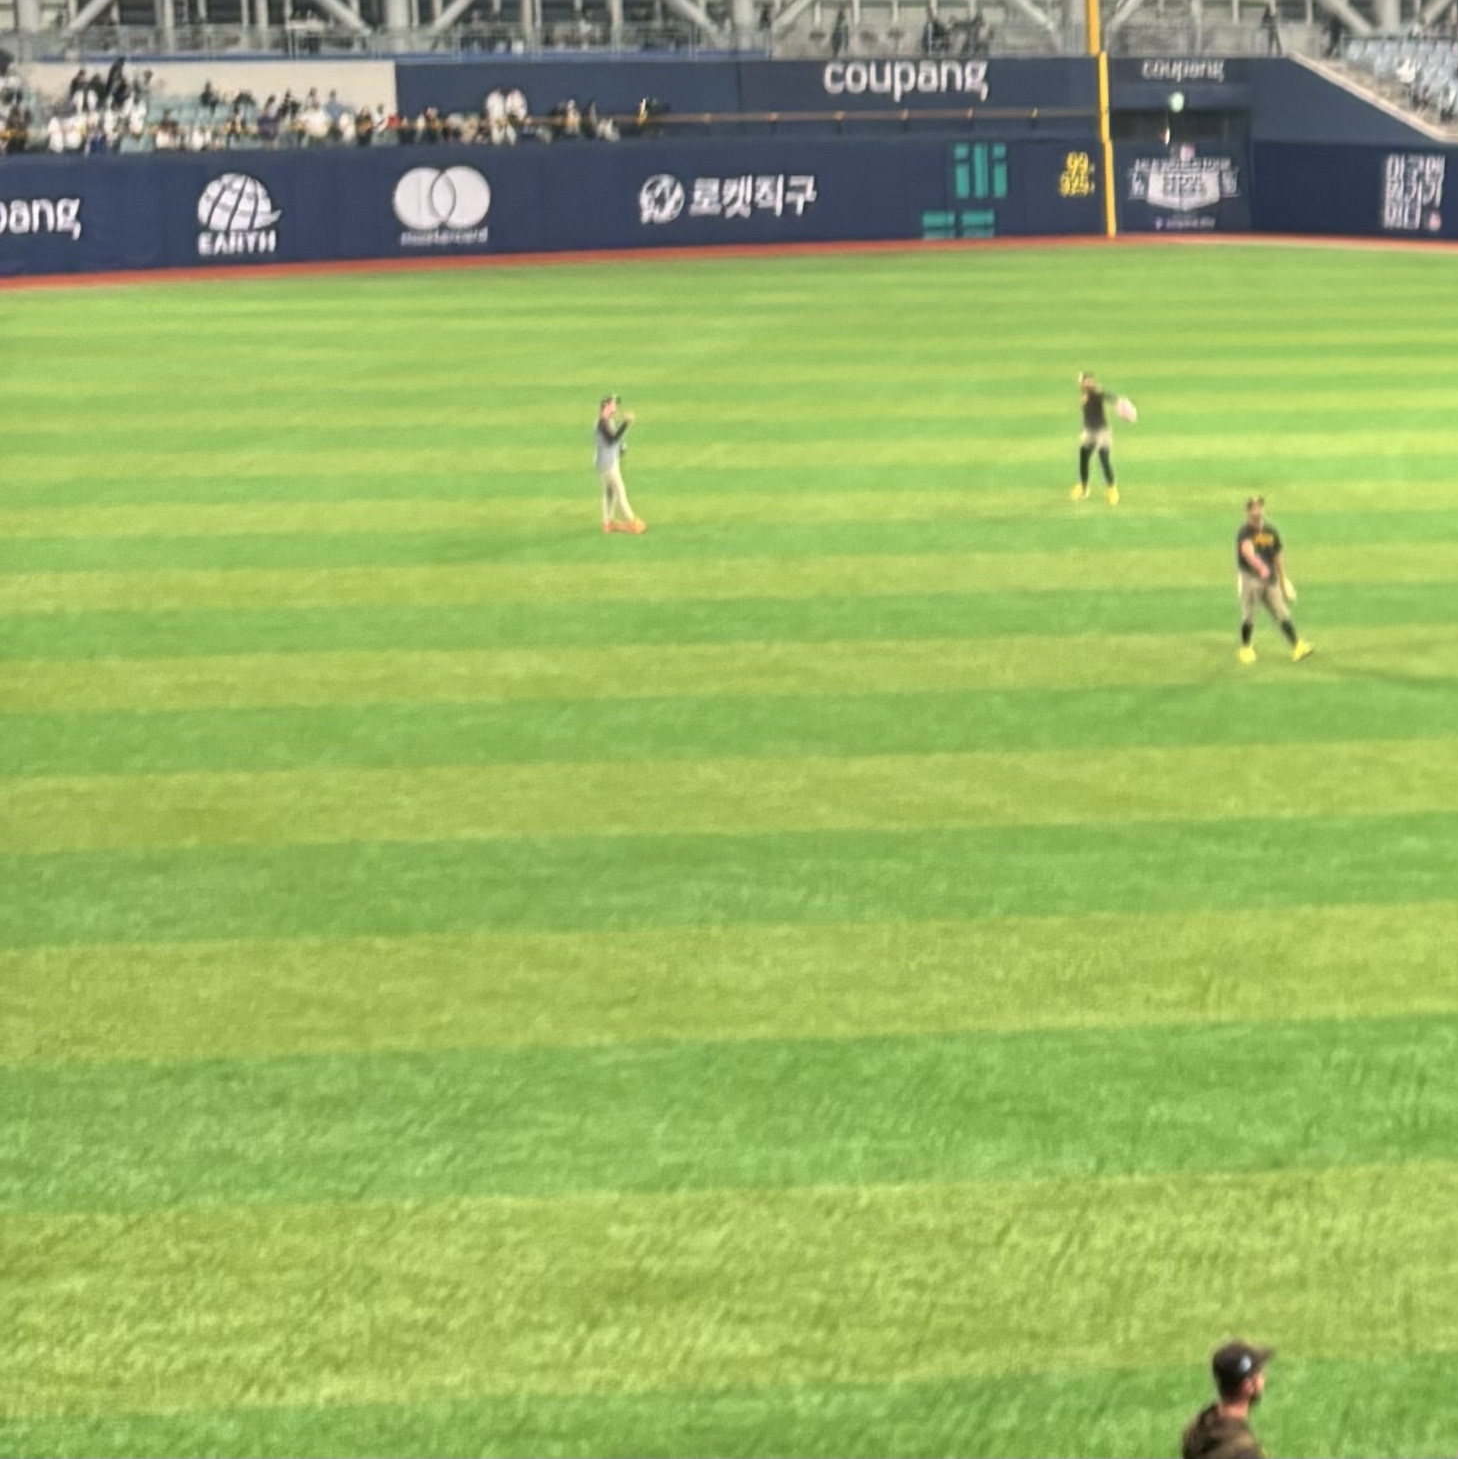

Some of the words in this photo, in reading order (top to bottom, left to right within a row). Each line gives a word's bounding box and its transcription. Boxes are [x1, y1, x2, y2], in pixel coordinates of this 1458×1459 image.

[823, 59, 989, 102] coupang
[1142, 59, 1225, 82] coupang
[689, 174, 817, 219] 로켓직구
